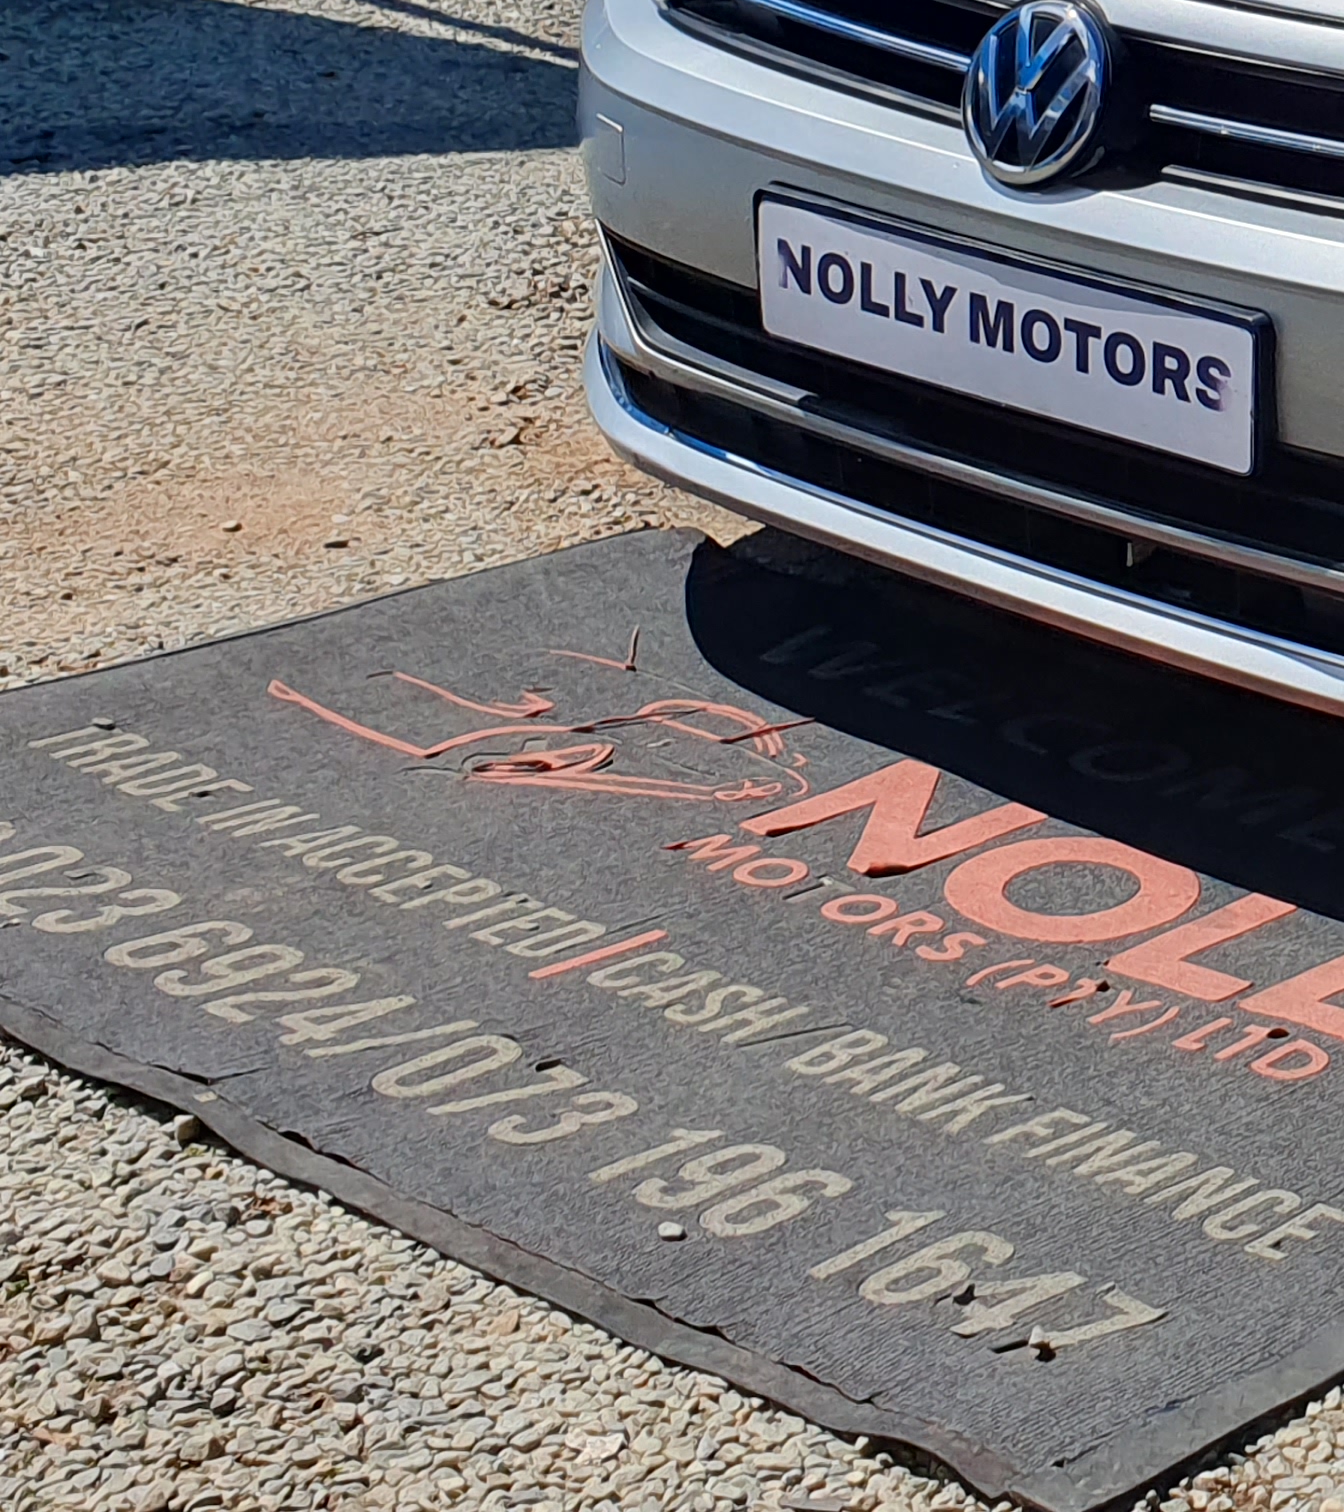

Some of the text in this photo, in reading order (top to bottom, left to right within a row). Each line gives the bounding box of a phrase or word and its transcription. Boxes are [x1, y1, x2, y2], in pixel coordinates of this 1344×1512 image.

[776, 236, 1233, 413] NOLLY MOTORS
[27, 724, 255, 812] TRADE
[194, 797, 321, 838] IN
[660, 833, 1331, 1081] MOTORS (PTY) LTD
[588, 1127, 853, 1238] 196
[809, 1209, 1168, 1348] 1647
